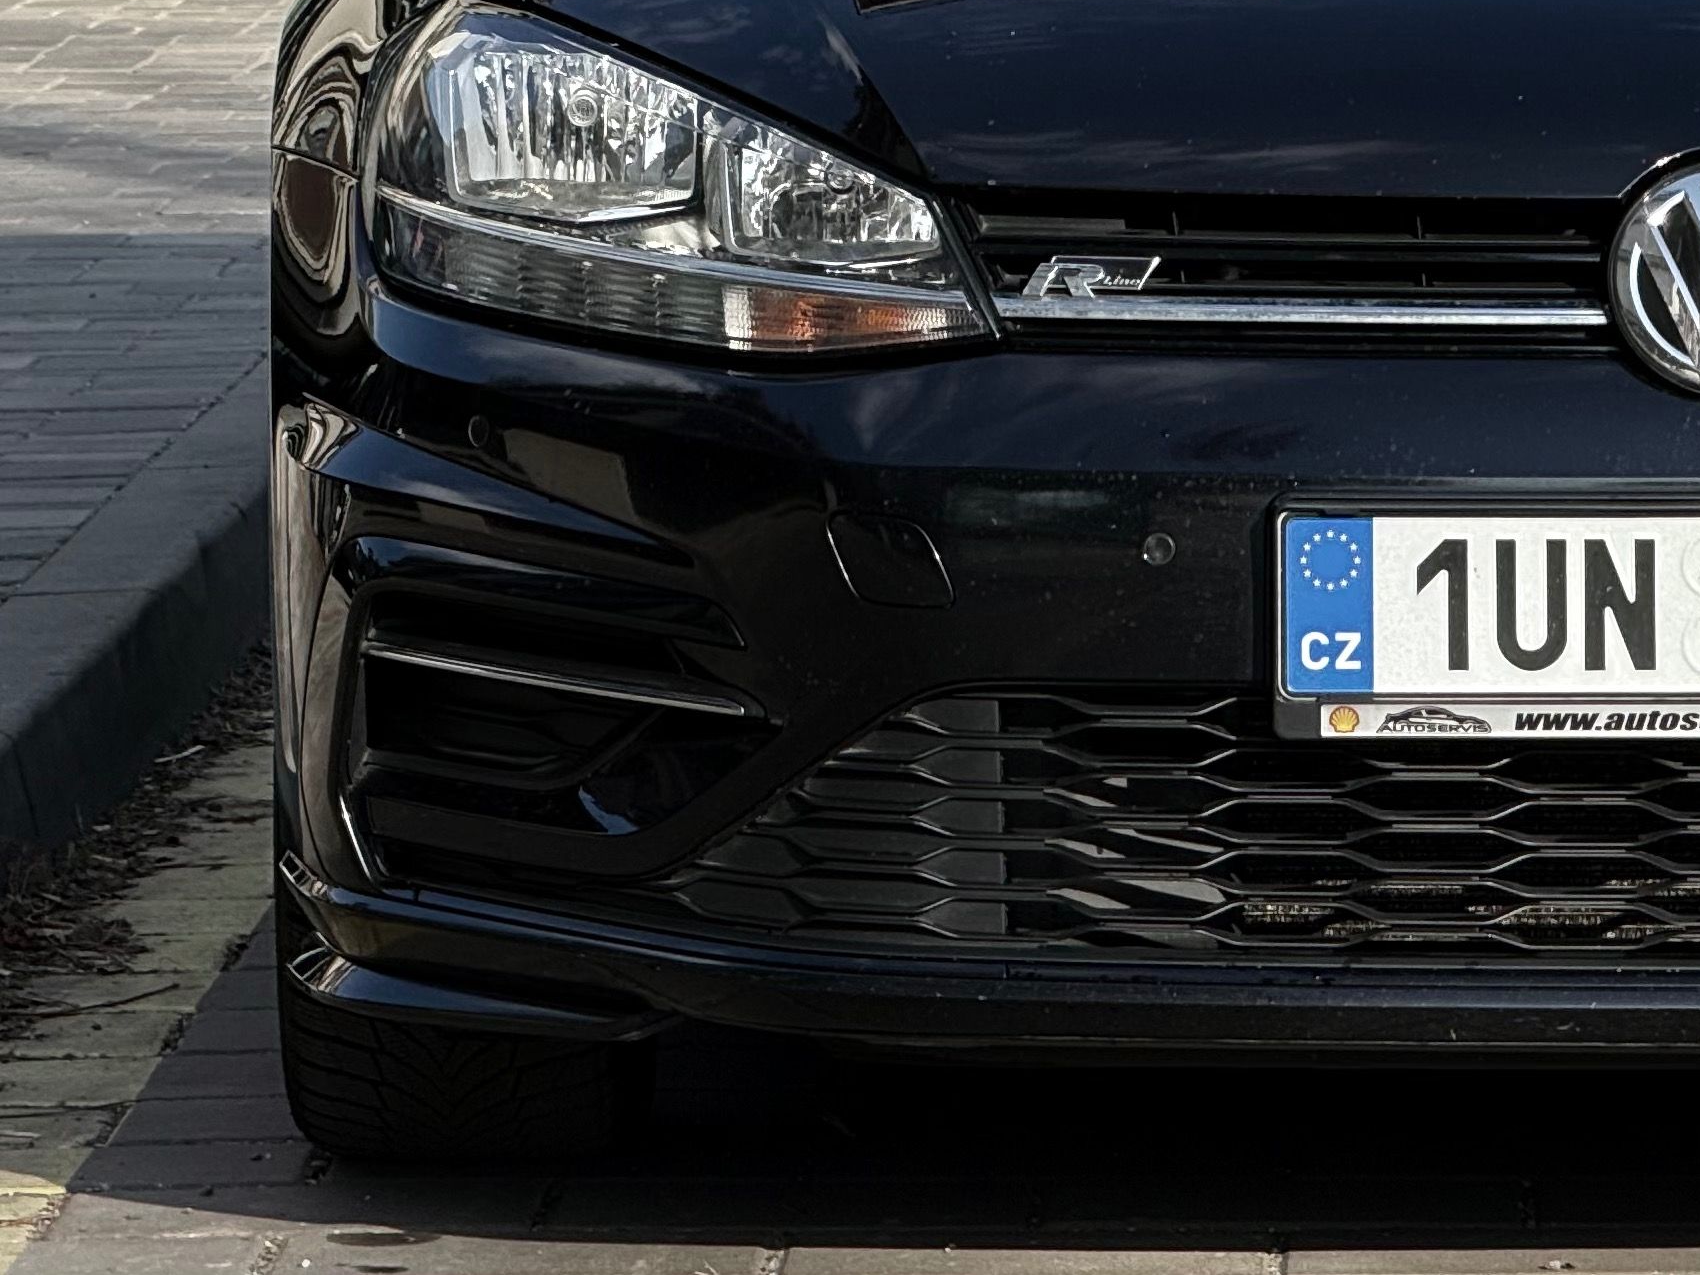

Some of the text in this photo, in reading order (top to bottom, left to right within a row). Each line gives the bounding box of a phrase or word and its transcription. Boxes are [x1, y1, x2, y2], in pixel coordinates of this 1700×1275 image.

[1415, 538, 1656, 671] 1UN
[1301, 631, 1362, 671] CZ
[1380, 722, 1489, 734] AUTOSERVIS
